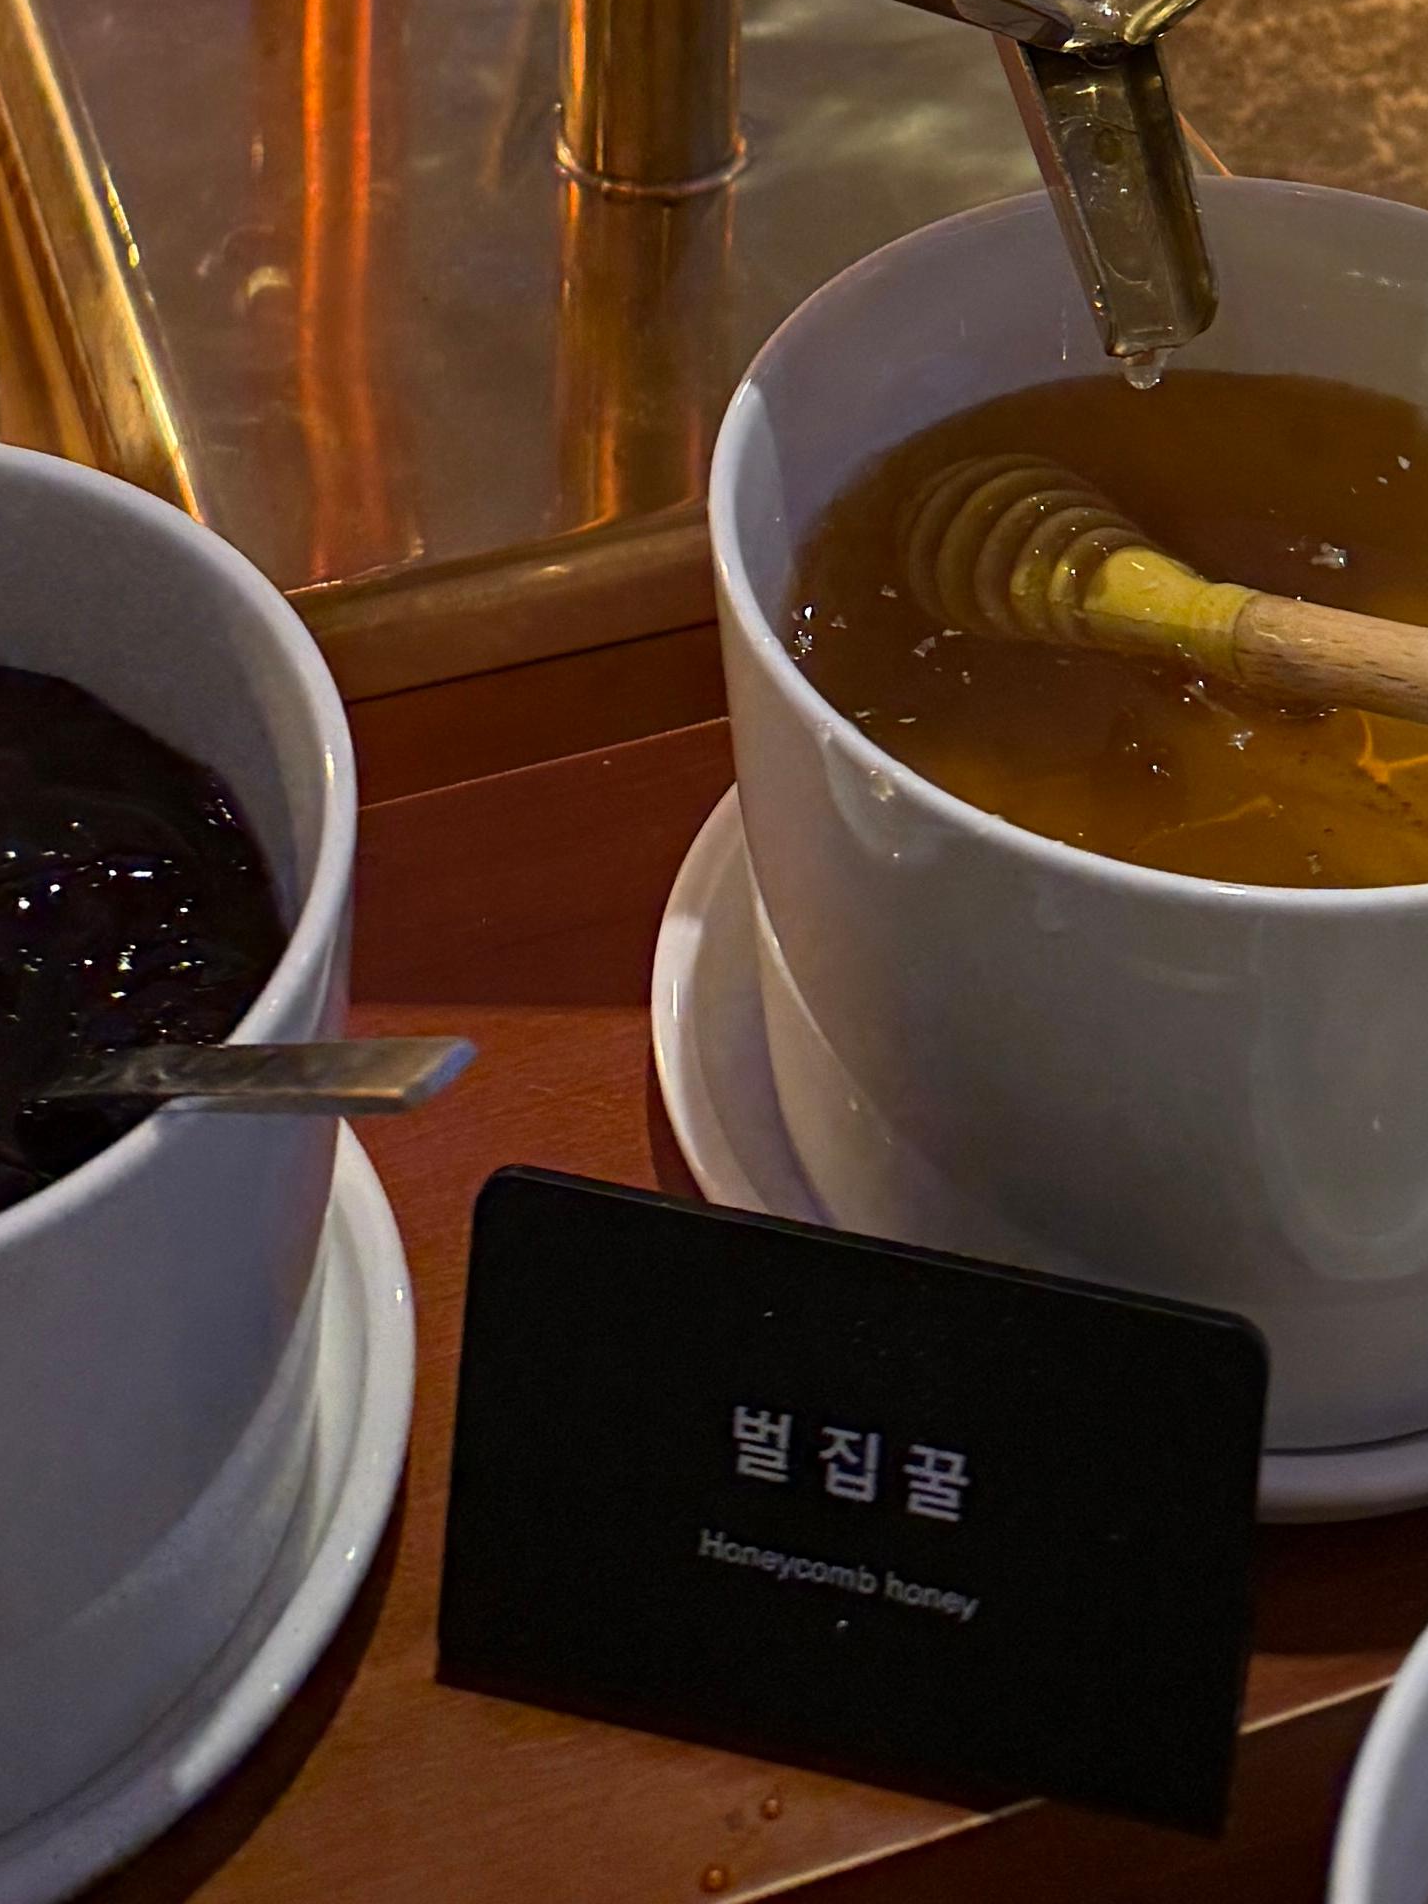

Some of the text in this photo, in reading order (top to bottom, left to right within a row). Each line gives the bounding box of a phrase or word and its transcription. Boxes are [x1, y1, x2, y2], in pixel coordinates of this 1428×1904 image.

[732, 1405, 970, 1523] 벌집꿀
[697, 1527, 980, 1623] Honeycomb honey
